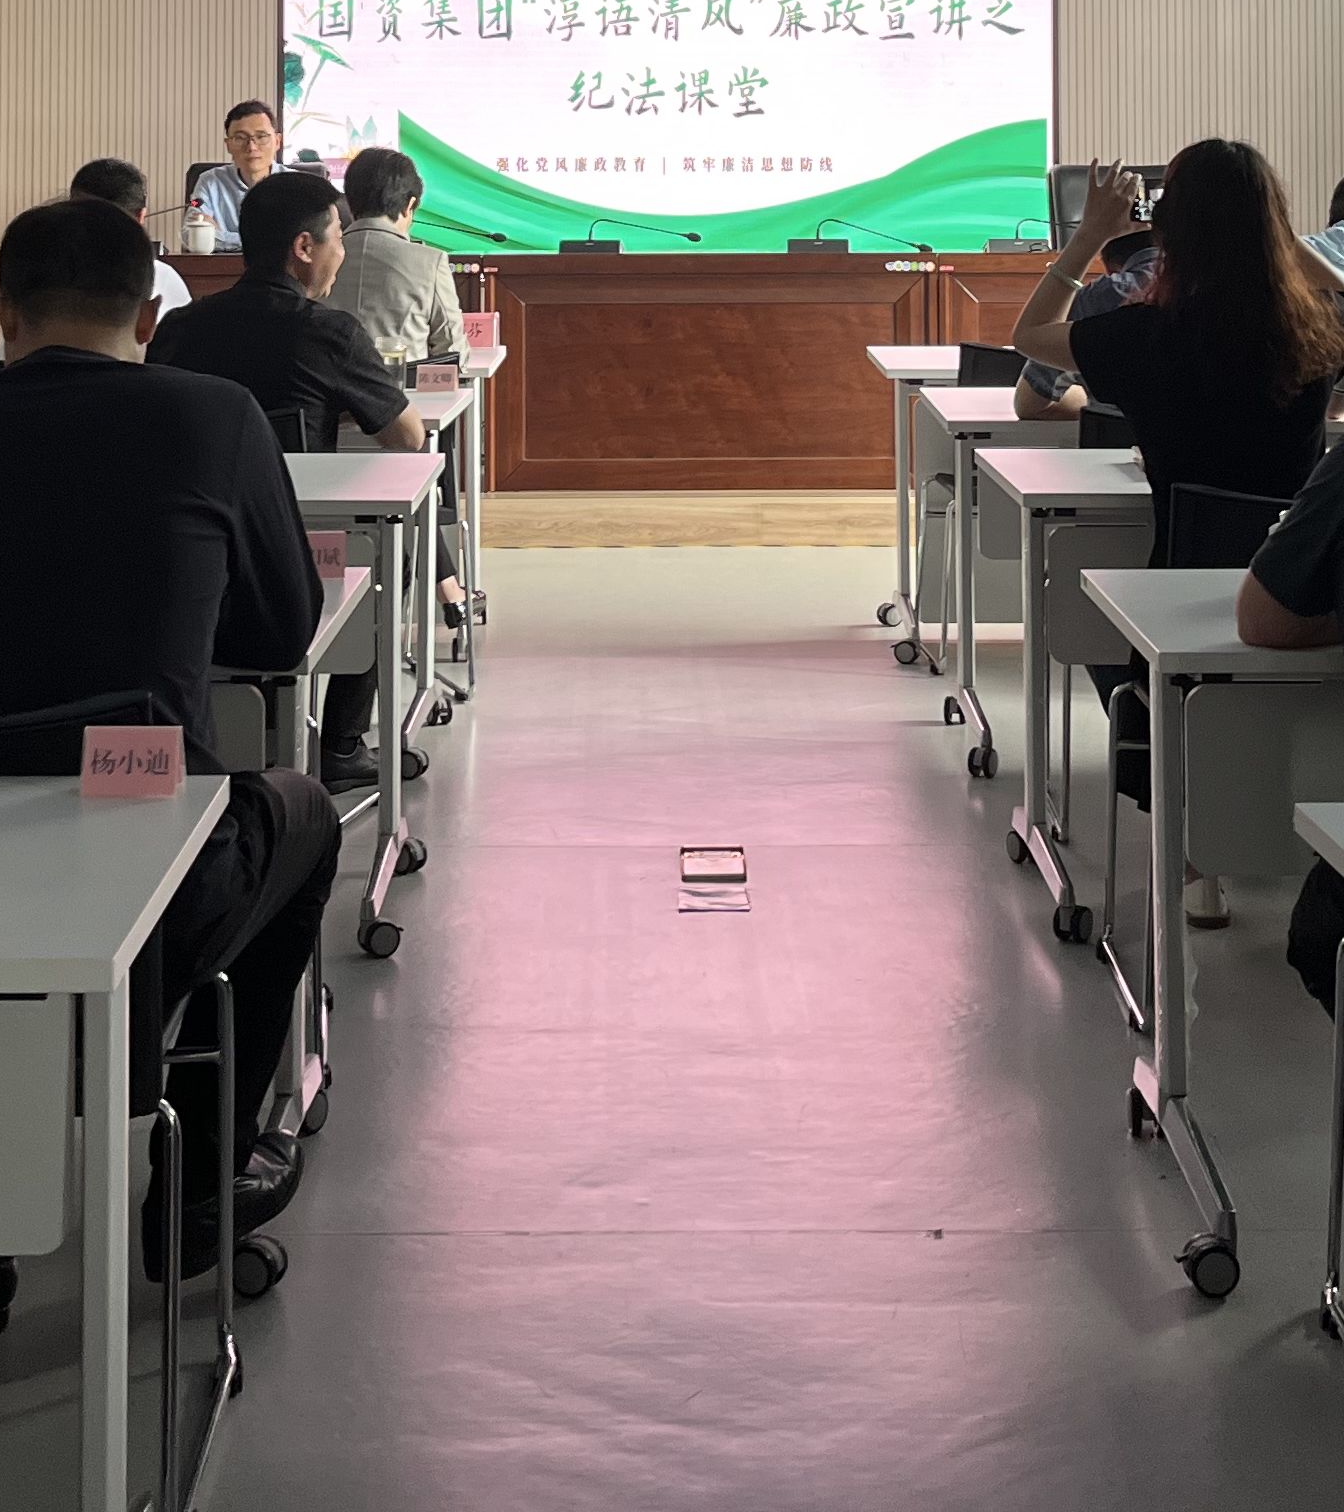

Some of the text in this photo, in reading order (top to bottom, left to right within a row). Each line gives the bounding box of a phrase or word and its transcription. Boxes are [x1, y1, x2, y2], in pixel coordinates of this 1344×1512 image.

[567, 65, 769, 118] 纪法课堂
[91, 747, 170, 775] 杨小迪
